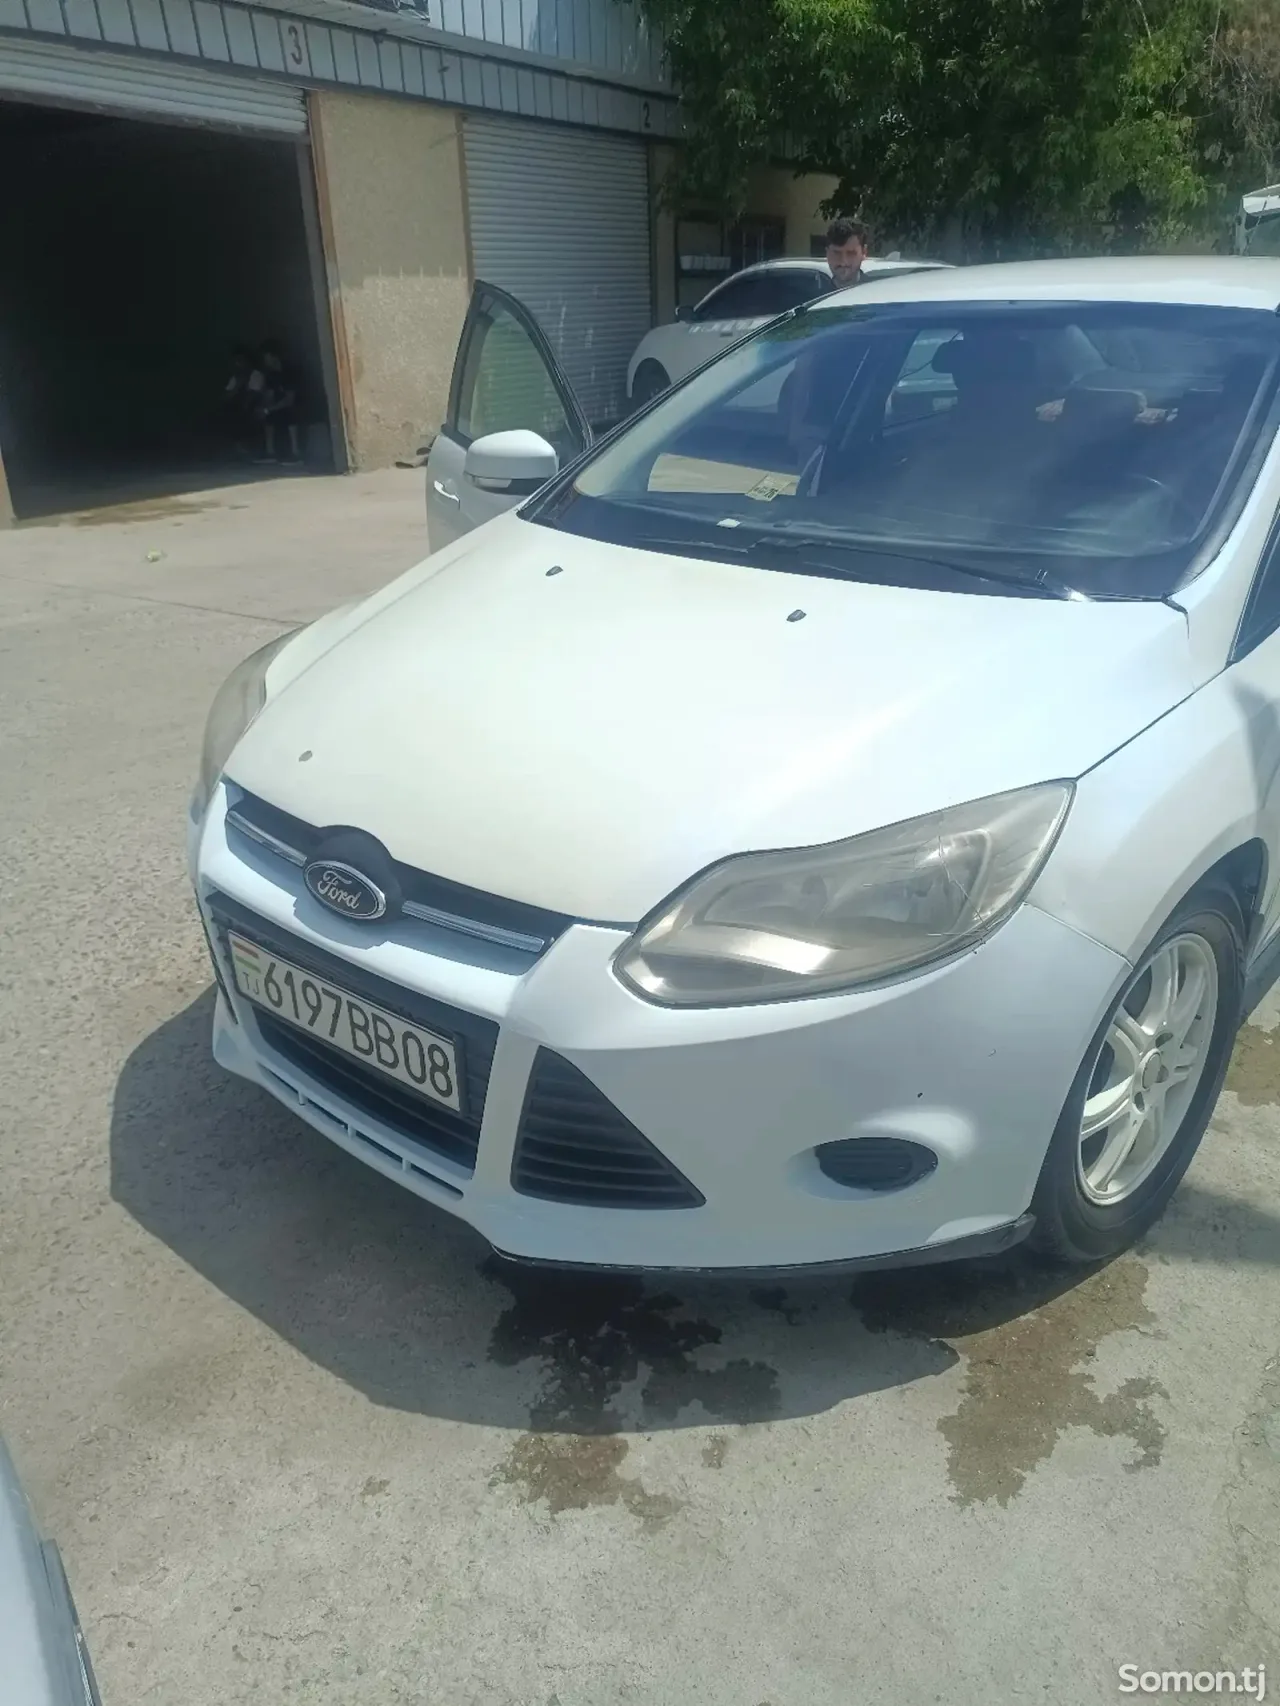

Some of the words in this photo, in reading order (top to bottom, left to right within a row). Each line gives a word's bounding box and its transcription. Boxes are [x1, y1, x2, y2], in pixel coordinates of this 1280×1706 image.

[288, 25, 303, 65] 3
[317, 870, 359, 909] Ford
[242, 971, 260, 995] TJ
